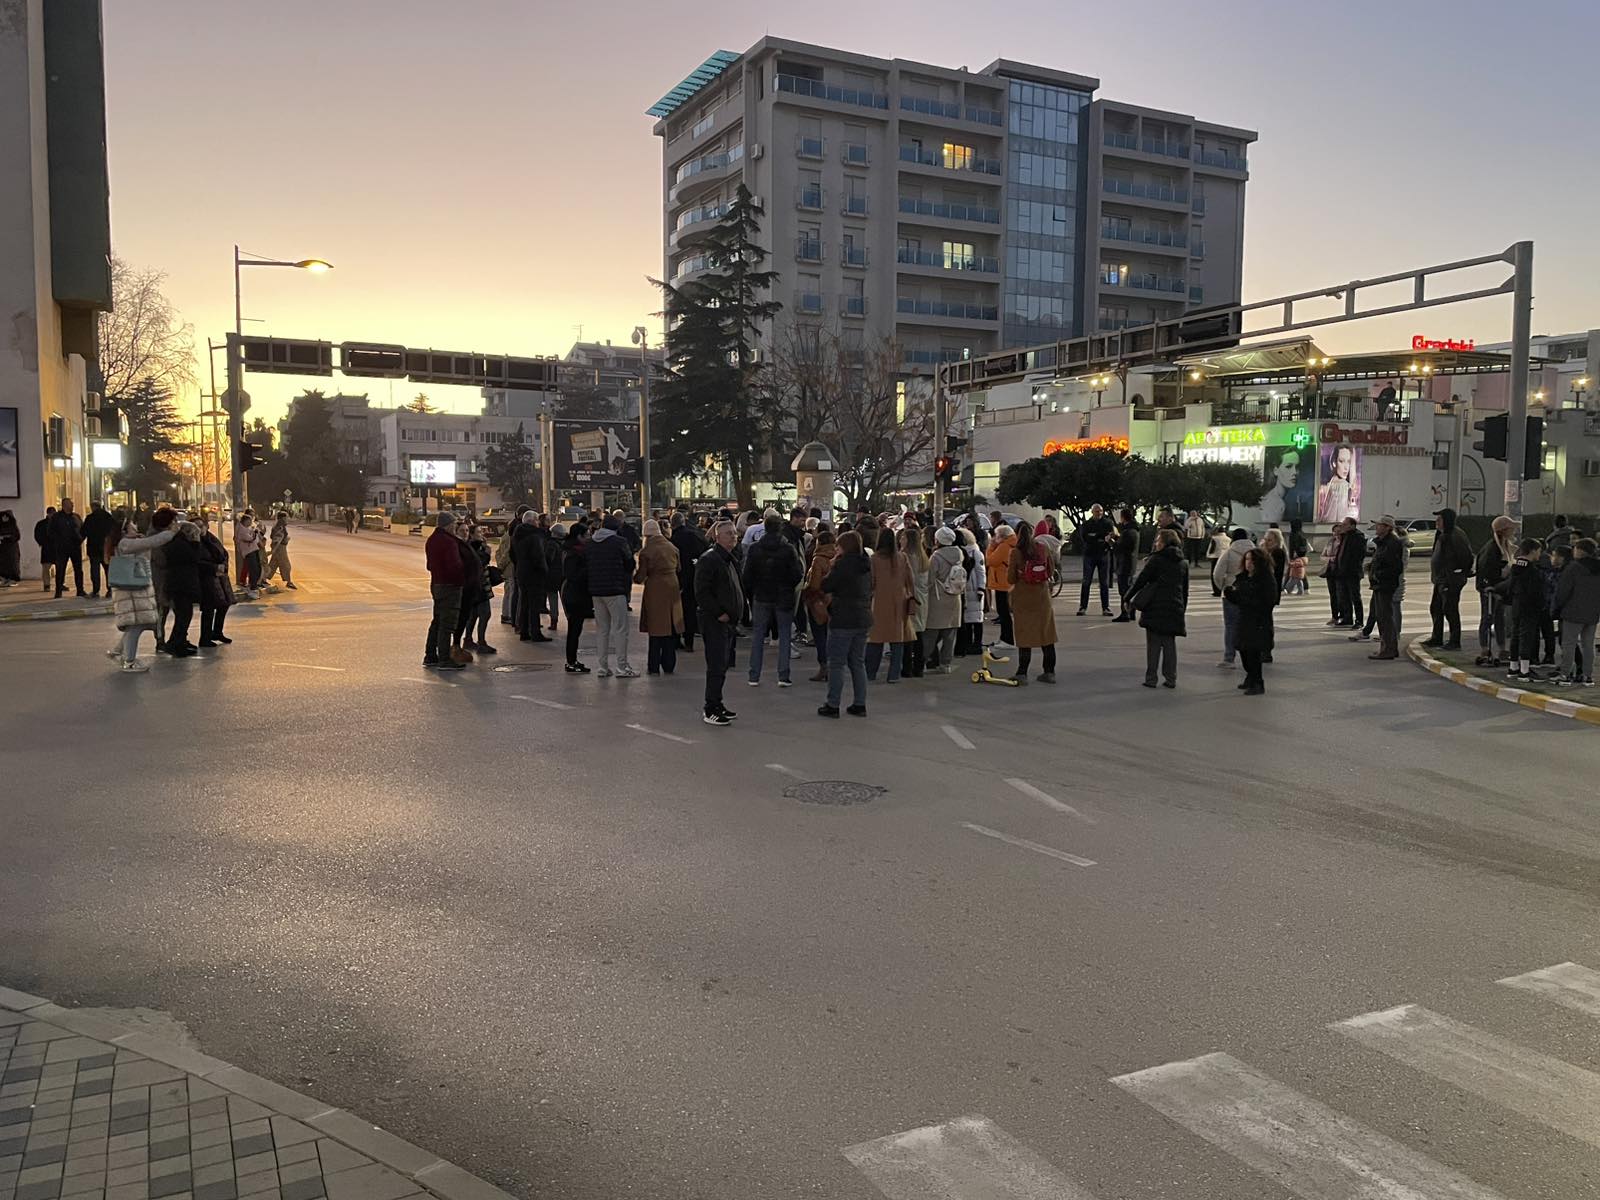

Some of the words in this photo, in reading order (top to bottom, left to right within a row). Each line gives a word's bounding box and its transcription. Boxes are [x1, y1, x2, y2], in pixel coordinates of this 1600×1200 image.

[1183, 428, 1265, 447] APOTEKA
[1320, 423, 1408, 445] Gradski
[1363, 446, 1425, 456] RESTAURANT
